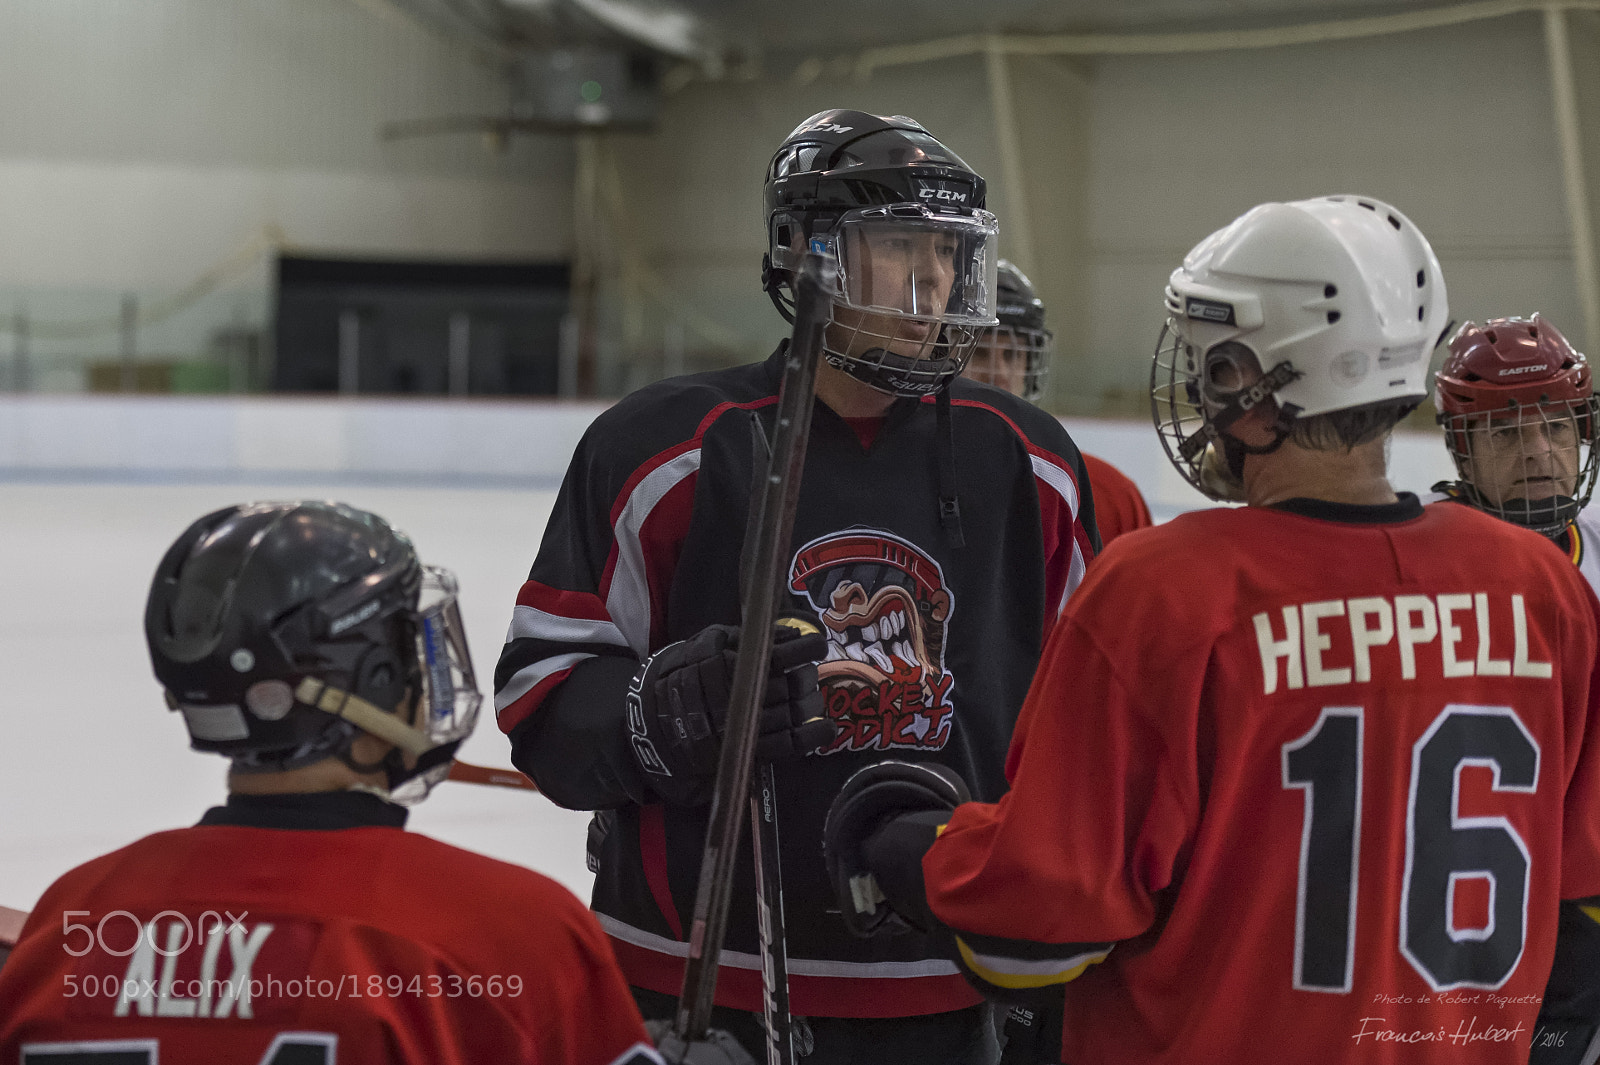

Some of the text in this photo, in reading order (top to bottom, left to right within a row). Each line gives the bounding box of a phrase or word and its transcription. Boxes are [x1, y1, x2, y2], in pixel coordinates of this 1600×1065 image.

[918, 188, 967, 203] CCM
[1498, 364, 1548, 377] EASTON
[1251, 592, 1553, 696] HEPPELL
[1281, 704, 1542, 994] 16
[114, 921, 274, 1019] ALIX
